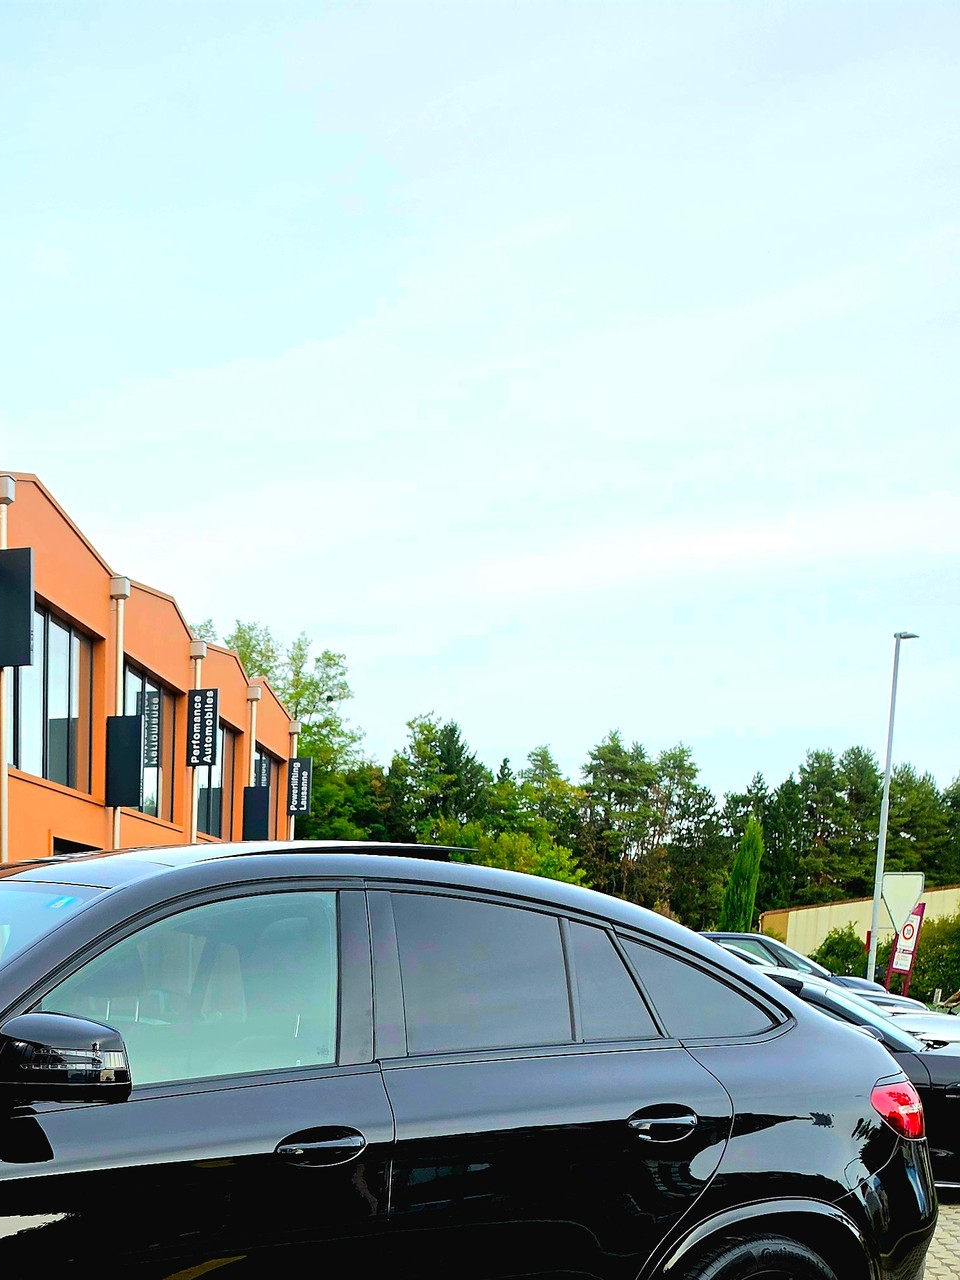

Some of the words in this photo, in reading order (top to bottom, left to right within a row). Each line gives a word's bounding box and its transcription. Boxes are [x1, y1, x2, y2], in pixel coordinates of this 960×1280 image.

[190, 695, 202, 764] Perfomance
[202, 690, 214, 763] Automobiles
[289, 762, 301, 811] Powerlifting
[298, 770, 309, 811] Lausanne
